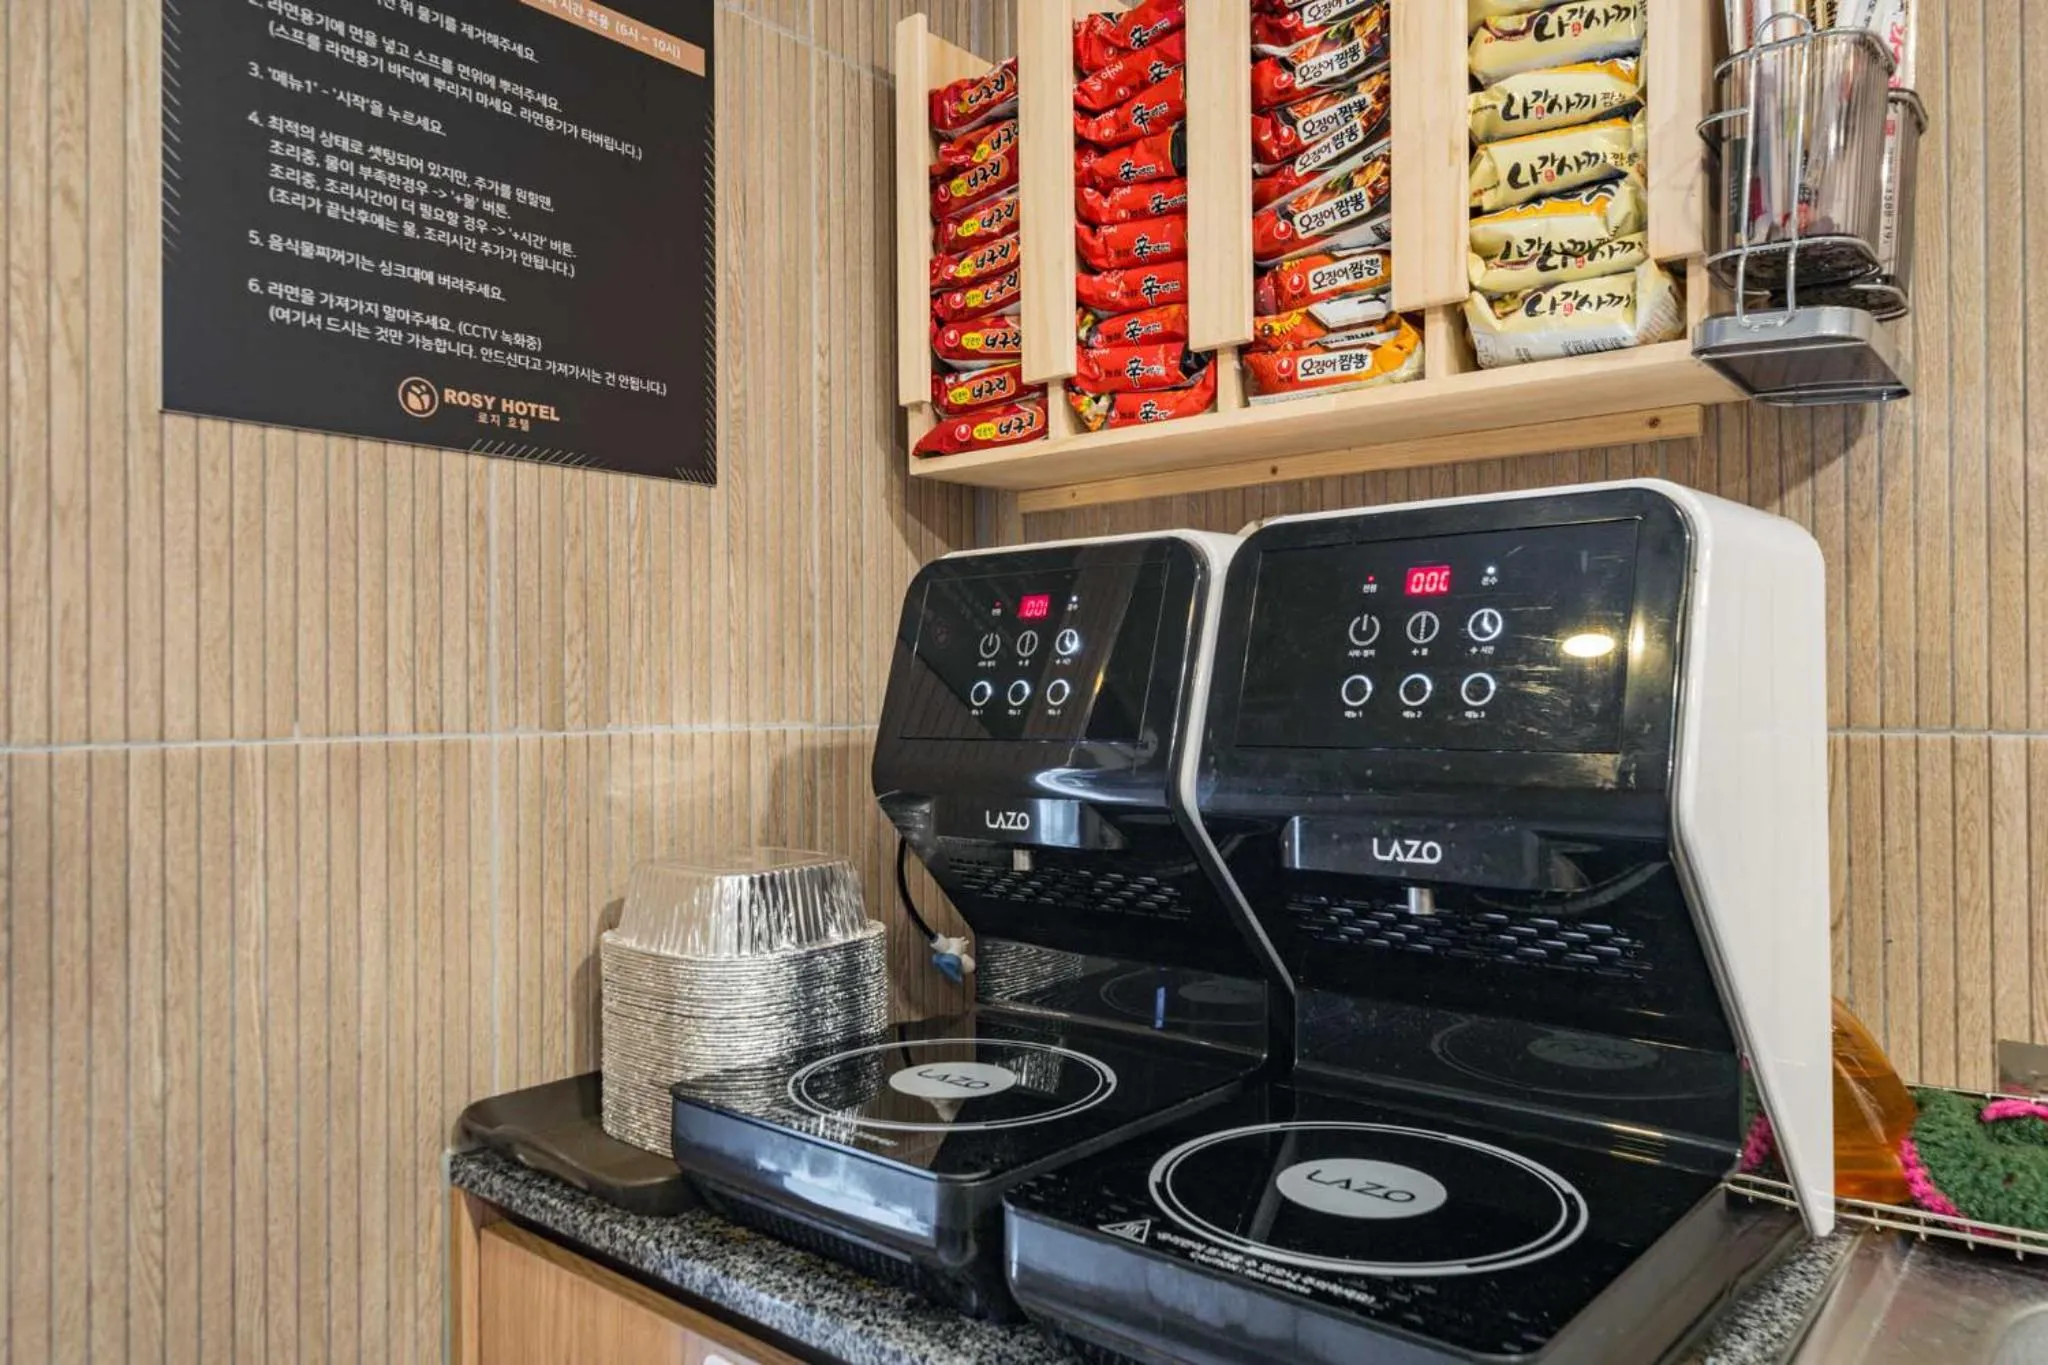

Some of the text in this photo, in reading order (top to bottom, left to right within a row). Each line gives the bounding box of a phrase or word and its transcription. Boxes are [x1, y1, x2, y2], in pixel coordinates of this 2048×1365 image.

[417, 5, 456, 34] 물기를
[460, 21, 539, 63] 제거해주세요.
[1533, 5, 1638, 43] 나가사끼
[267, 0, 345, 38] 라면용기에
[348, 24, 377, 48] 면을
[413, 50, 454, 74] 스프를
[457, 60, 496, 91] 면위에
[499, 77, 563, 112] 뿌려주세요.
[268, 20, 320, 52] (스프를
[325, 39, 384, 73] 라면용기
[387, 61, 430, 89] 바닥에
[433, 77, 473, 104] 뿌리지
[475, 91, 517, 117] 마세요.
[519, 106, 579, 139] 라면용기가
[248, 61, 264, 79] 3.
[387, 105, 447, 136] 누르세요.
[1501, 88, 1597, 121] 나가사끼
[248, 110, 264, 127] 4.
[266, 113, 316, 143] 최적의
[319, 129, 365, 156] 상태로
[368, 141, 425, 173] 셋팅되어
[474, 175, 512, 200] 추가를
[324, 153, 354, 177] 물이
[358, 163, 428, 196] 부족한경우
[967, 160, 1001, 188] 너구리
[323, 177, 398, 211] 조리시간이
[401, 198, 416, 216] 더
[418, 202, 460, 228] 필요할
[463, 214, 488, 234] 경우
[981, 200, 1015, 229] 너구리
[1298, 191, 1366, 235] 오징어짬뽕
[268, 185, 323, 214] (조리가
[325, 200, 400, 234] 끝난후에는
[423, 226, 477, 253] 조리시간
[479, 241, 517, 264] 추가가
[248, 229, 507, 302] 5. 음식물찌꺼기는 싱크대에 버려주세요.
[975, 243, 1010, 270] 너구리
[1311, 256, 1381, 291] 오징어짬뽕
[248, 277, 543, 352] 6. 라면을 가져가지 말아주세요. (CCTV 녹화중)
[268, 304, 323, 331] (여기서
[326, 316, 372, 340] 드시는
[374, 325, 404, 346] 것만
[406, 332, 477, 359] 가능합니다.
[480, 346, 543, 372] 안드신다고
[545, 359, 602, 385] 가져가시는
[605, 371, 616, 388] 건
[1299, 352, 1369, 378] 오징어짬뽕
[443, 387, 561, 422] ROSY HOTEL
[972, 376, 1007, 399] 너구리
[477, 411, 530, 432] 로지 호텔
[998, 414, 1035, 435] 너구리
[985, 809, 1030, 831] LAZO
[1372, 837, 1442, 865] LAZO
[917, 1068, 990, 1090] LAZO
[1306, 1168, 1416, 1203] LAZO
